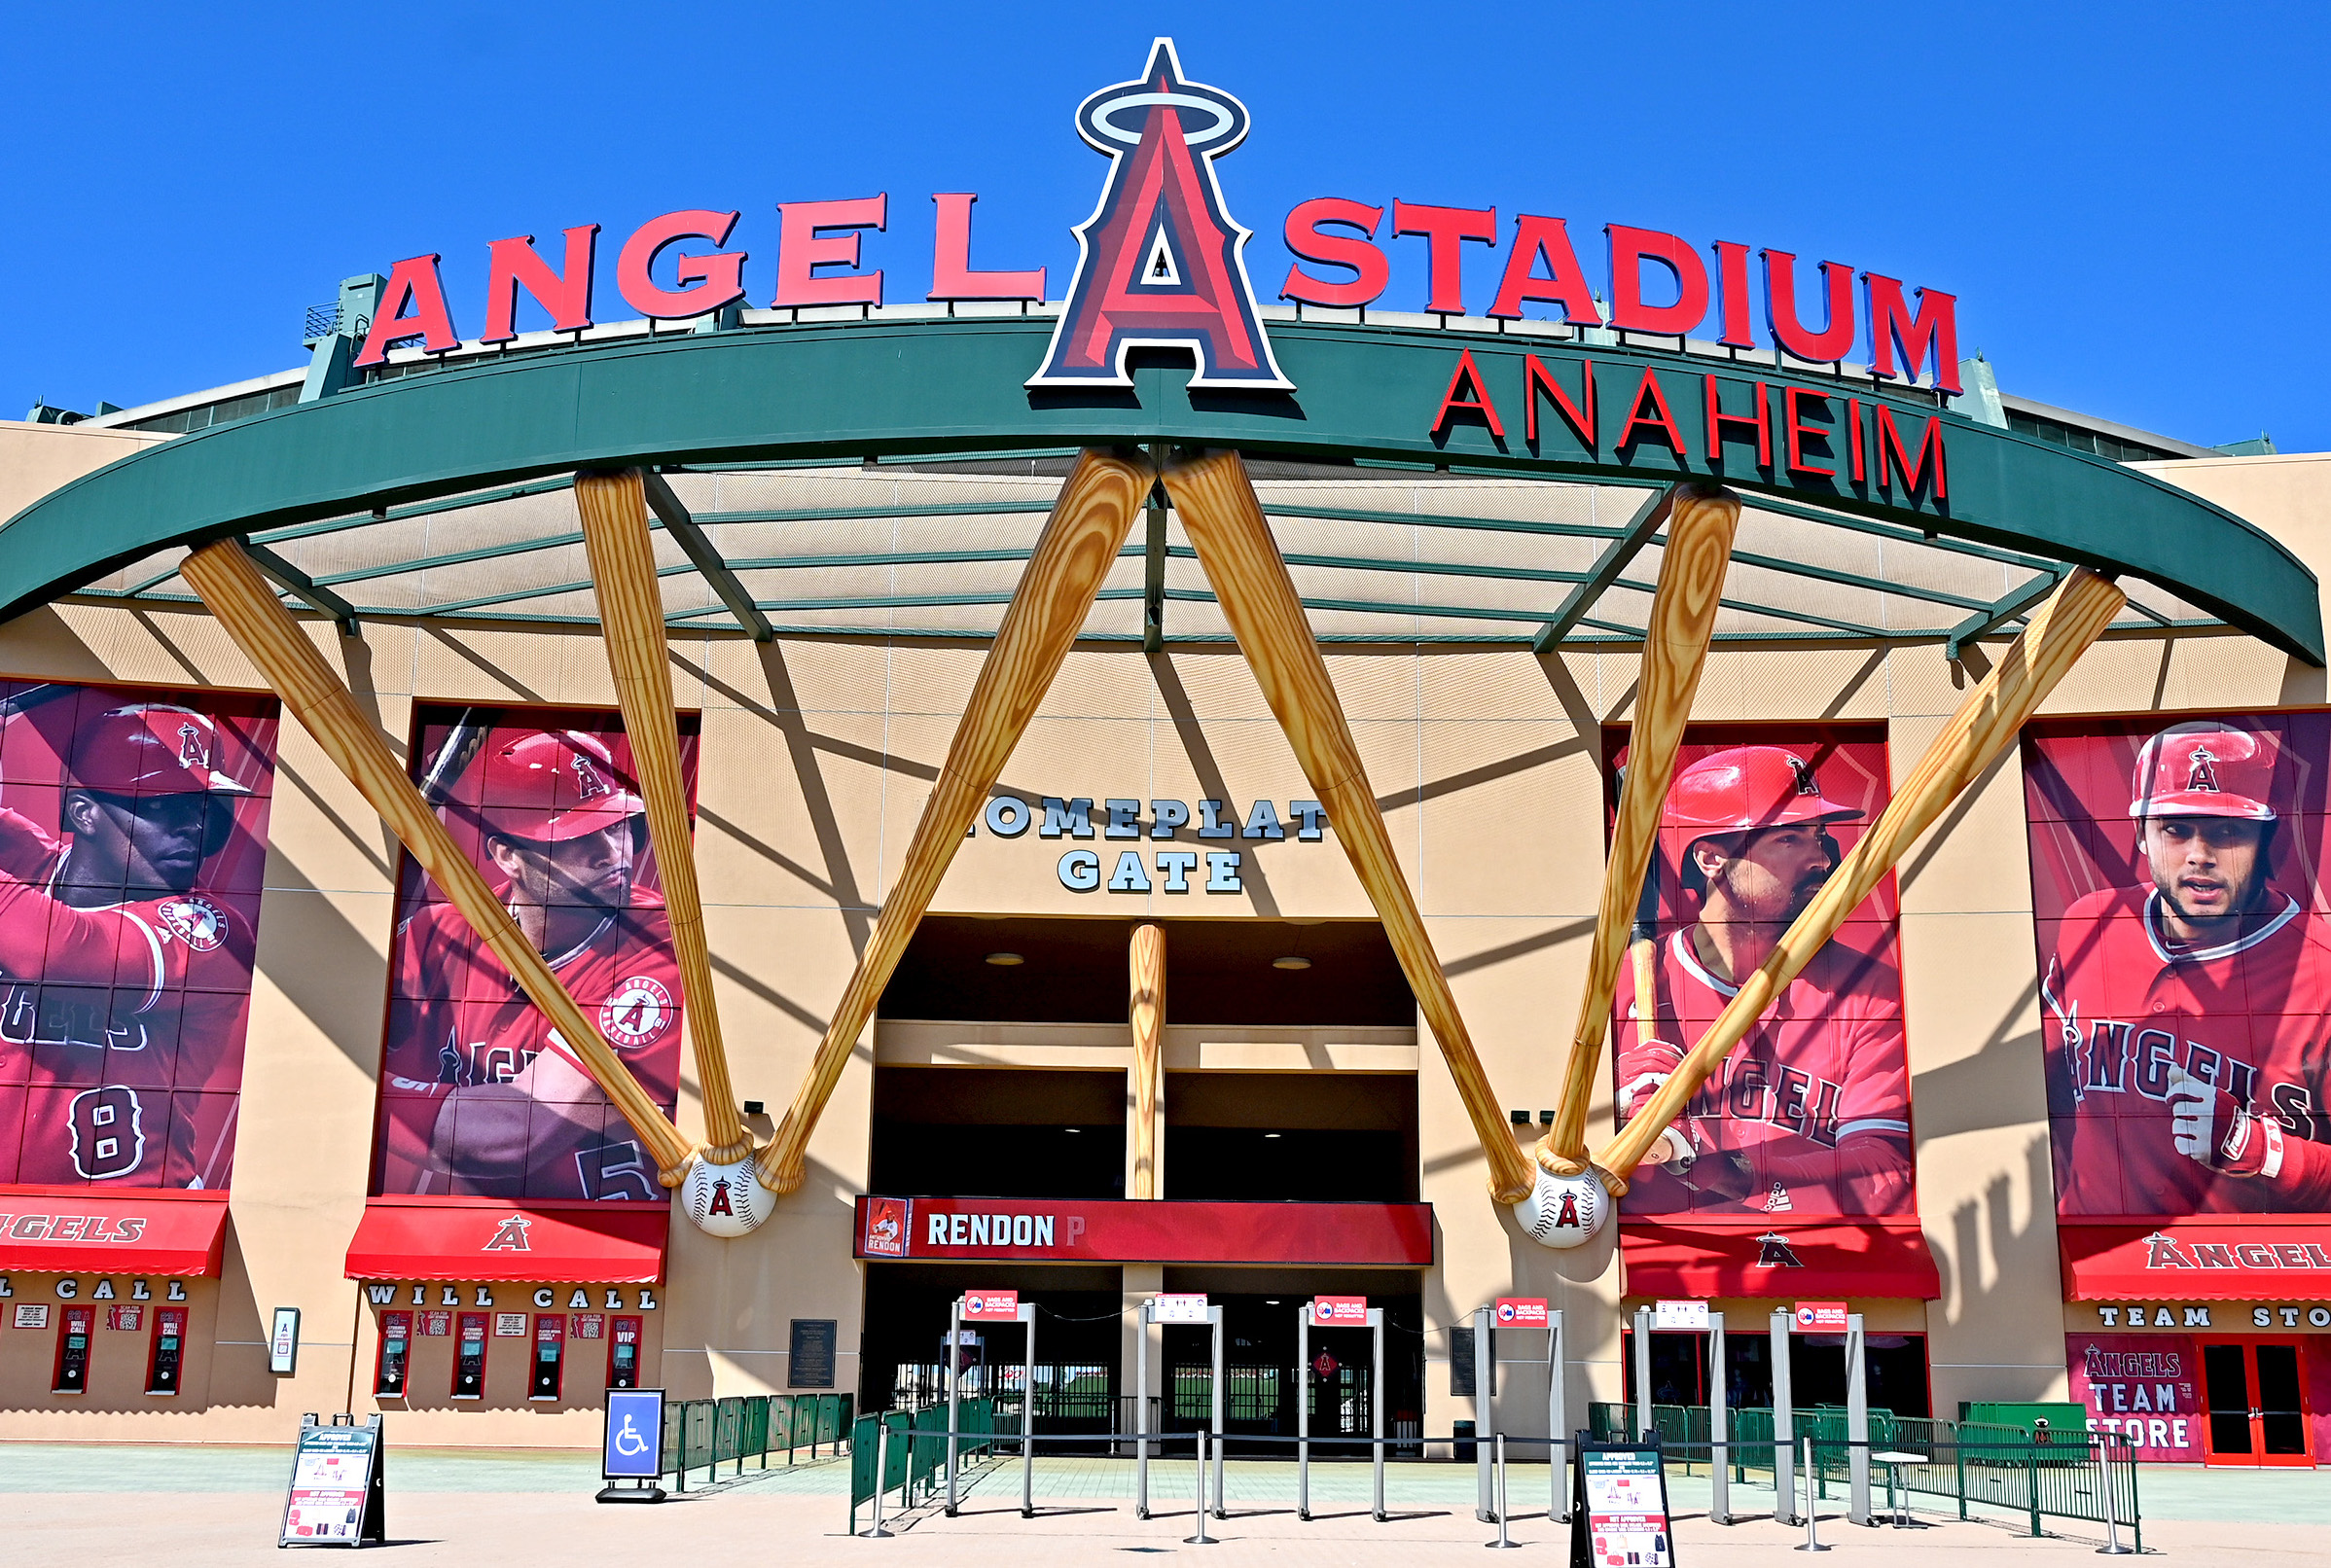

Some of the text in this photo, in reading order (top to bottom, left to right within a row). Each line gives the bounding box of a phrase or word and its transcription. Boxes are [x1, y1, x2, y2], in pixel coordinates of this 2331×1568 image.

[1023, 37, 1297, 391] A
[354, 192, 1962, 396] ANGEL STADIUM
[1429, 346, 1947, 501] ANAHEIM
[571, 753, 610, 799] A
[1785, 754, 1821, 796] A
[2187, 745, 2220, 793] A
[967, 795, 1327, 841] OMEPLAT
[1058, 849, 1242, 895] GATE
[626, 979, 667, 1005] ANGELS
[66, 1085, 146, 1180] 8
[709, 1175, 734, 1216] A
[1555, 1188, 1580, 1228] A
[0, 1214, 147, 1242] GELS
[481, 1214, 532, 1251] A
[869, 1240, 901, 1252] RENDON
[928, 1213, 1086, 1246] RENDON P
[1755, 1230, 1805, 1267] A
[55, 1279, 186, 1301] CALL
[369, 1284, 656, 1309] WILL CALL
[2098, 1305, 2211, 1328] TEAM
[617, 1332, 635, 1342] VIP
[2083, 1343, 2181, 1377] ANGELS
[2089, 1383, 2175, 1411] TEAM
[2086, 1418, 2190, 1447] STORE
